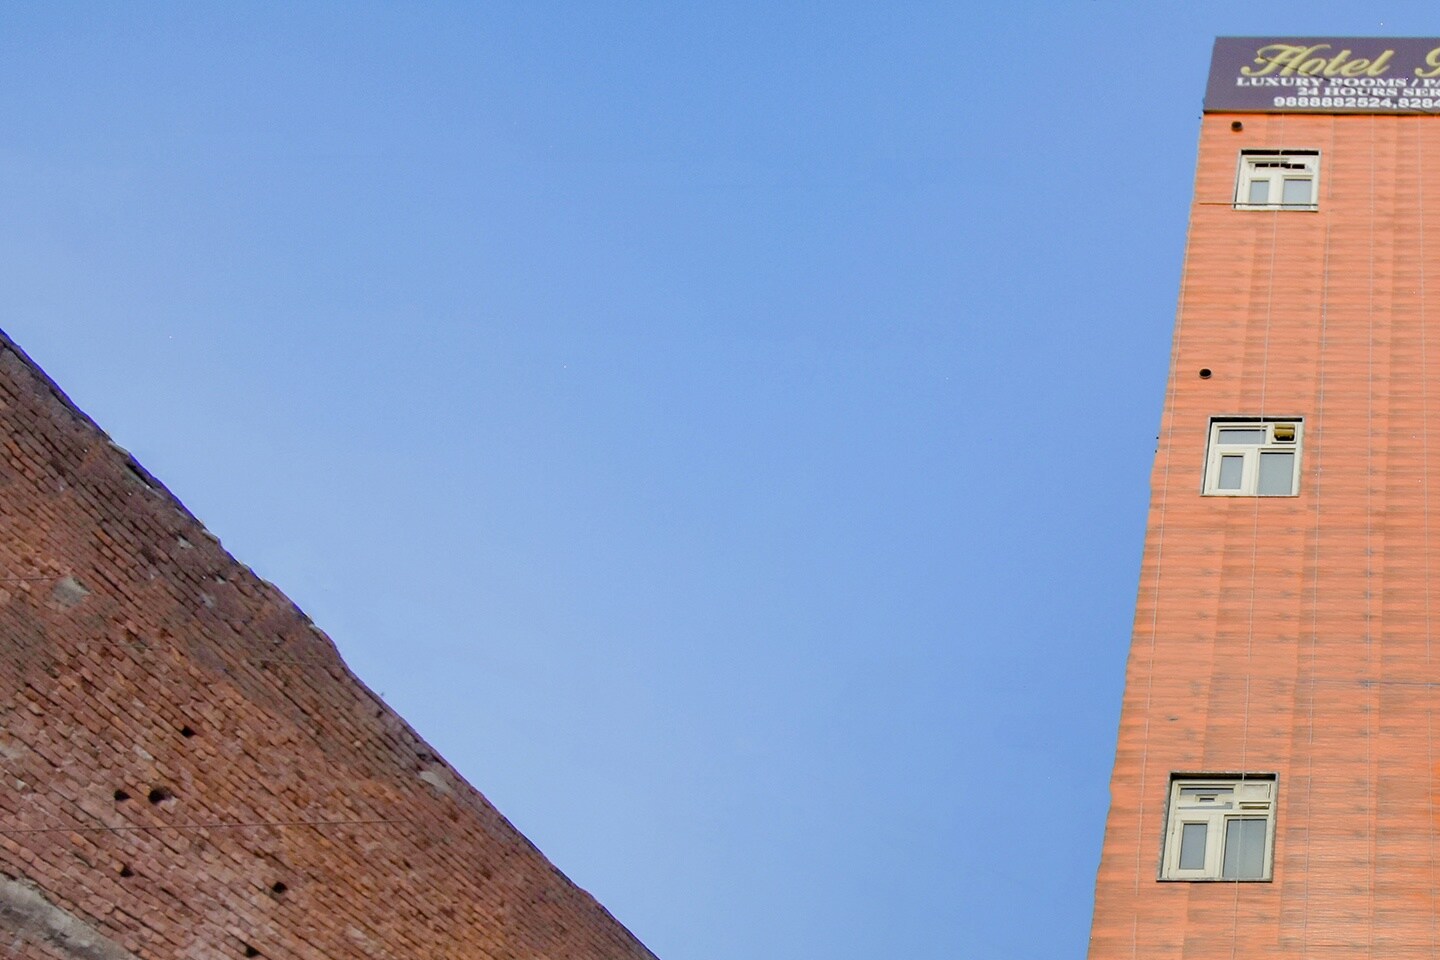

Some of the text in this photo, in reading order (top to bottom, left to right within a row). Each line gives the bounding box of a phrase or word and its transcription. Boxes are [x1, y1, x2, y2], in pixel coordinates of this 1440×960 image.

[1240, 44, 1396, 77] Hotel
[1236, 77, 1325, 87] LUXURY
[1329, 78, 1408, 88] ROOMS
[1297, 87, 1319, 97] 24
[1323, 87, 1398, 97] HOURS
